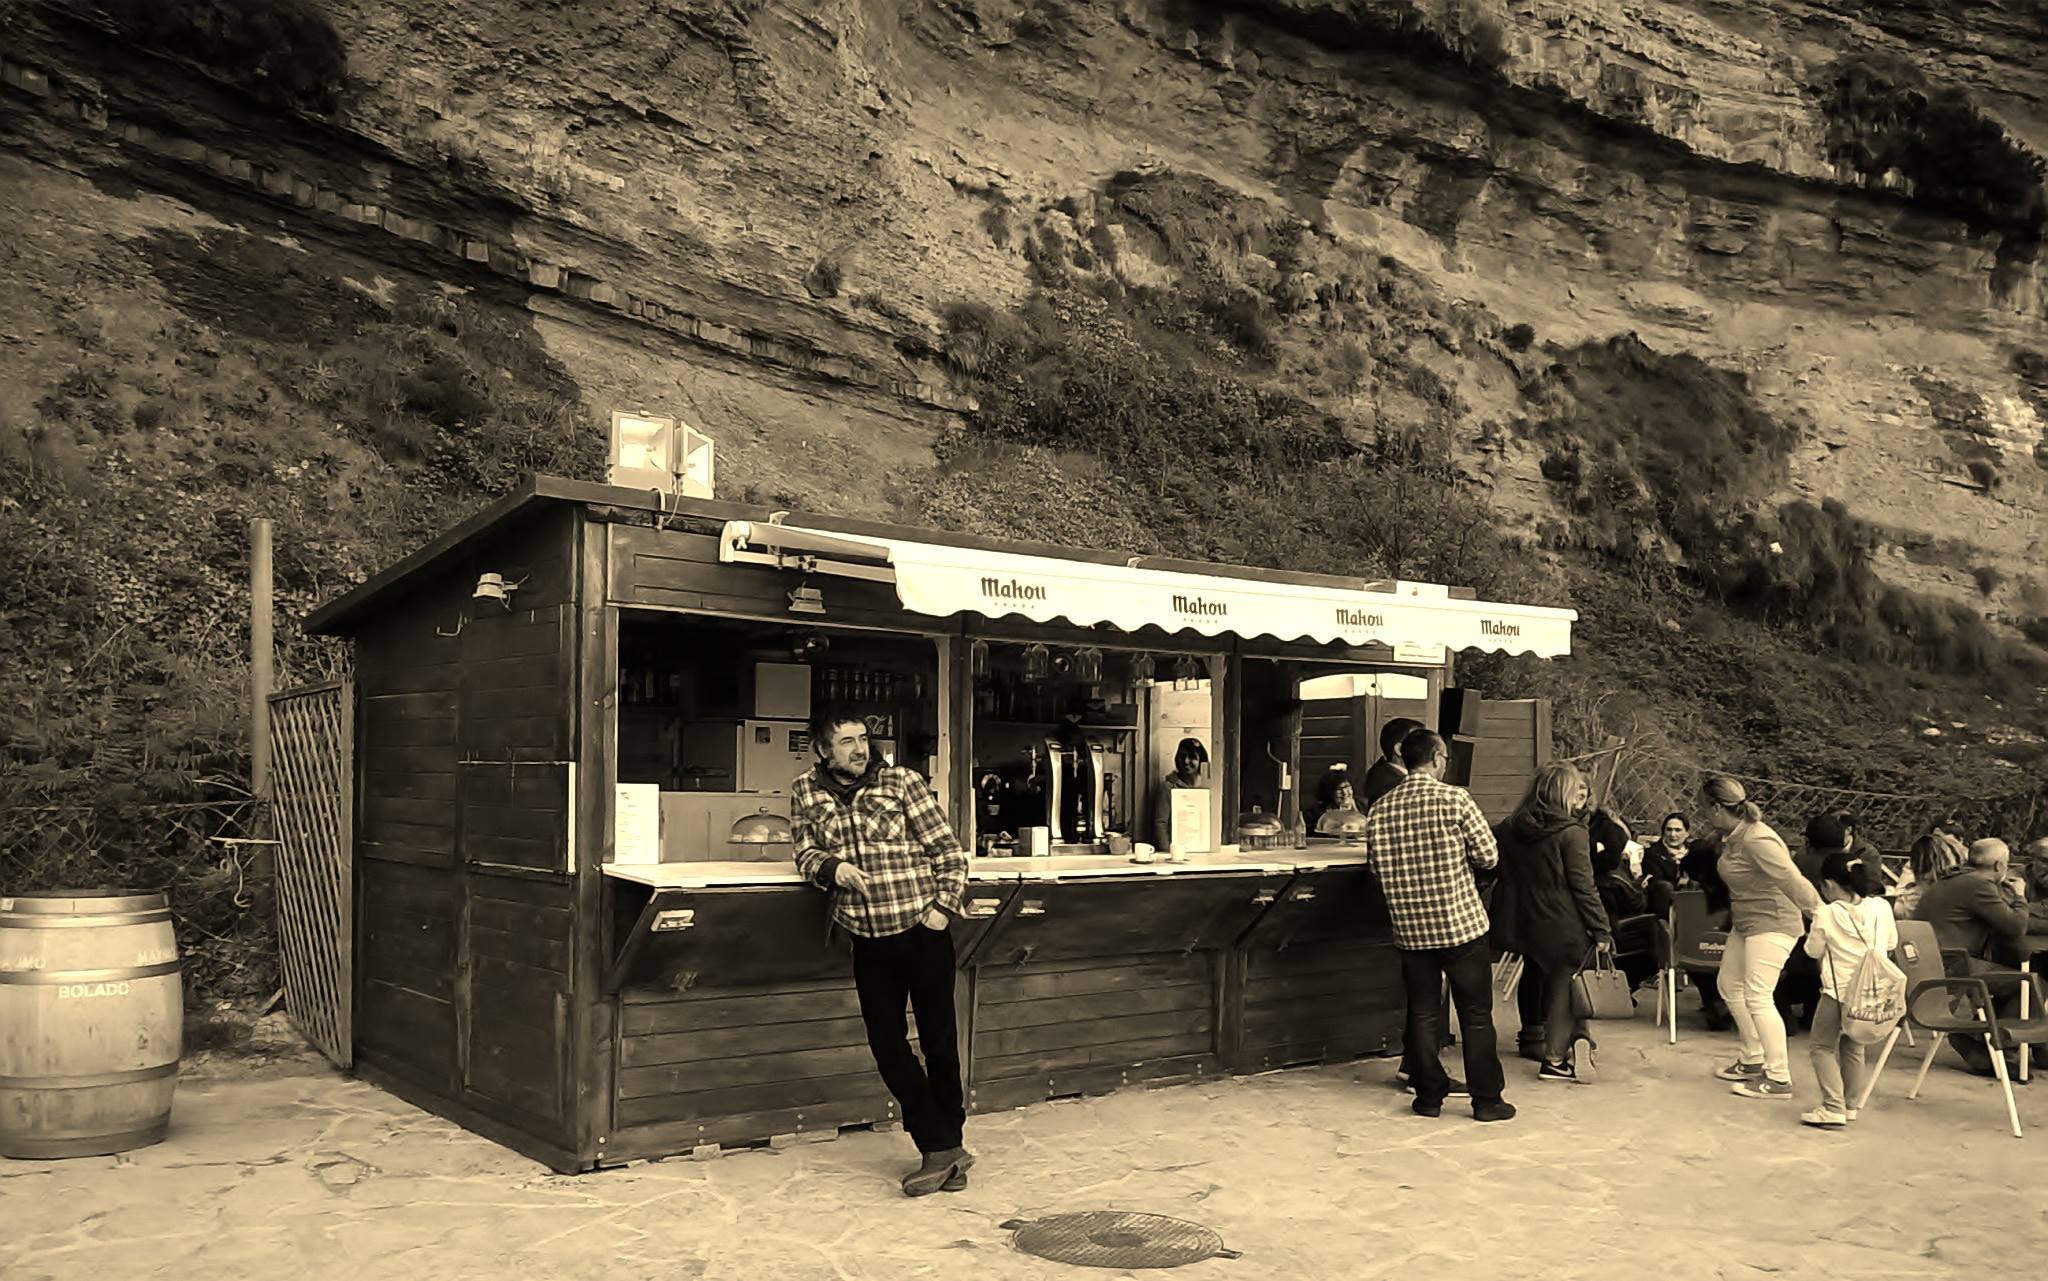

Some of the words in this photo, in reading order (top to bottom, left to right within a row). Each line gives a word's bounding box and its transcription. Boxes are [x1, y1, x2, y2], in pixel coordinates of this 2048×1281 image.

[981, 577, 1046, 600] Mahou
[1173, 595, 1227, 615] Mahou
[1336, 609, 1383, 626] Mahou
[1480, 619, 1520, 636] Mahou
[1699, 942, 1728, 950] Maho
[59, 983, 129, 999] BOLADO
